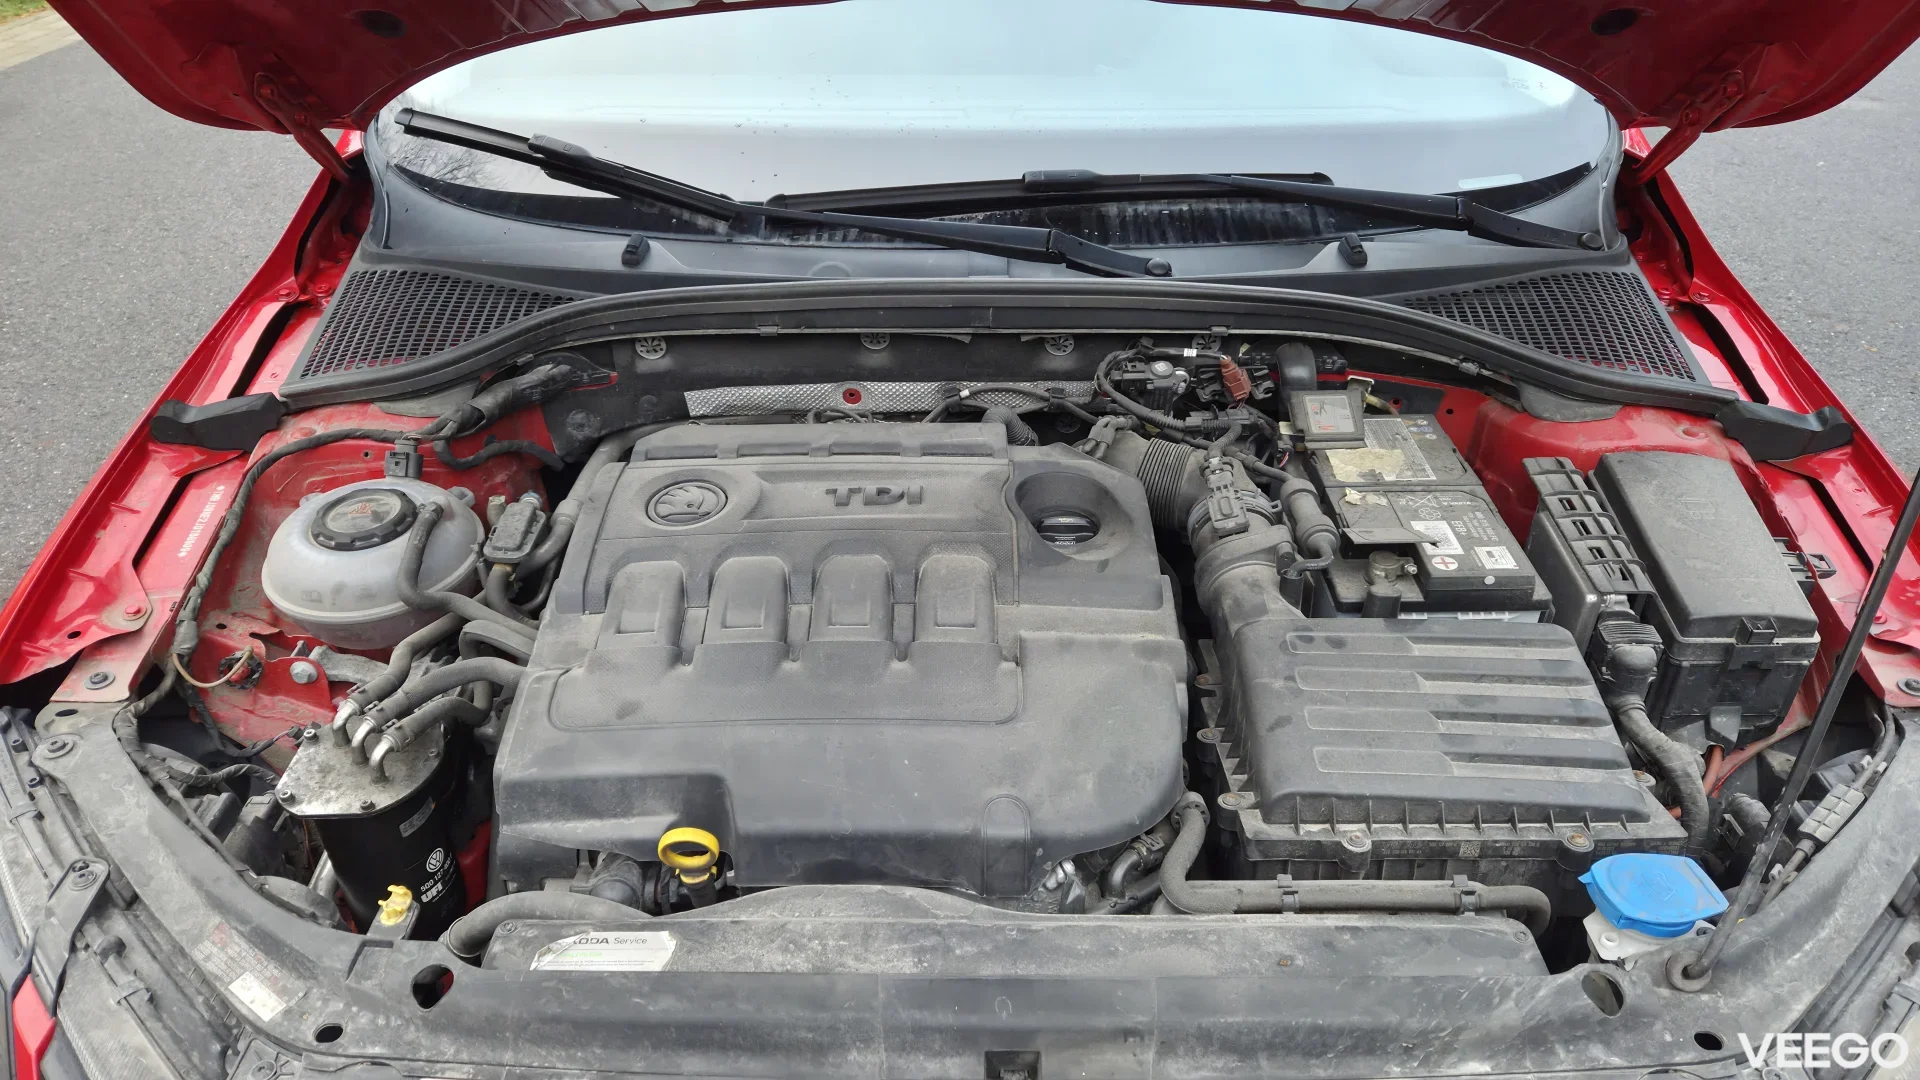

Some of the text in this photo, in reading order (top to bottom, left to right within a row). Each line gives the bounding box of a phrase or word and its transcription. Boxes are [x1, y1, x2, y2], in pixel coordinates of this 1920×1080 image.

[824, 485, 923, 506] TDI
[1451, 520, 1467, 536] EFB+
[421, 881, 442, 902] UFI
[574, 937, 648, 945] ODA Service
